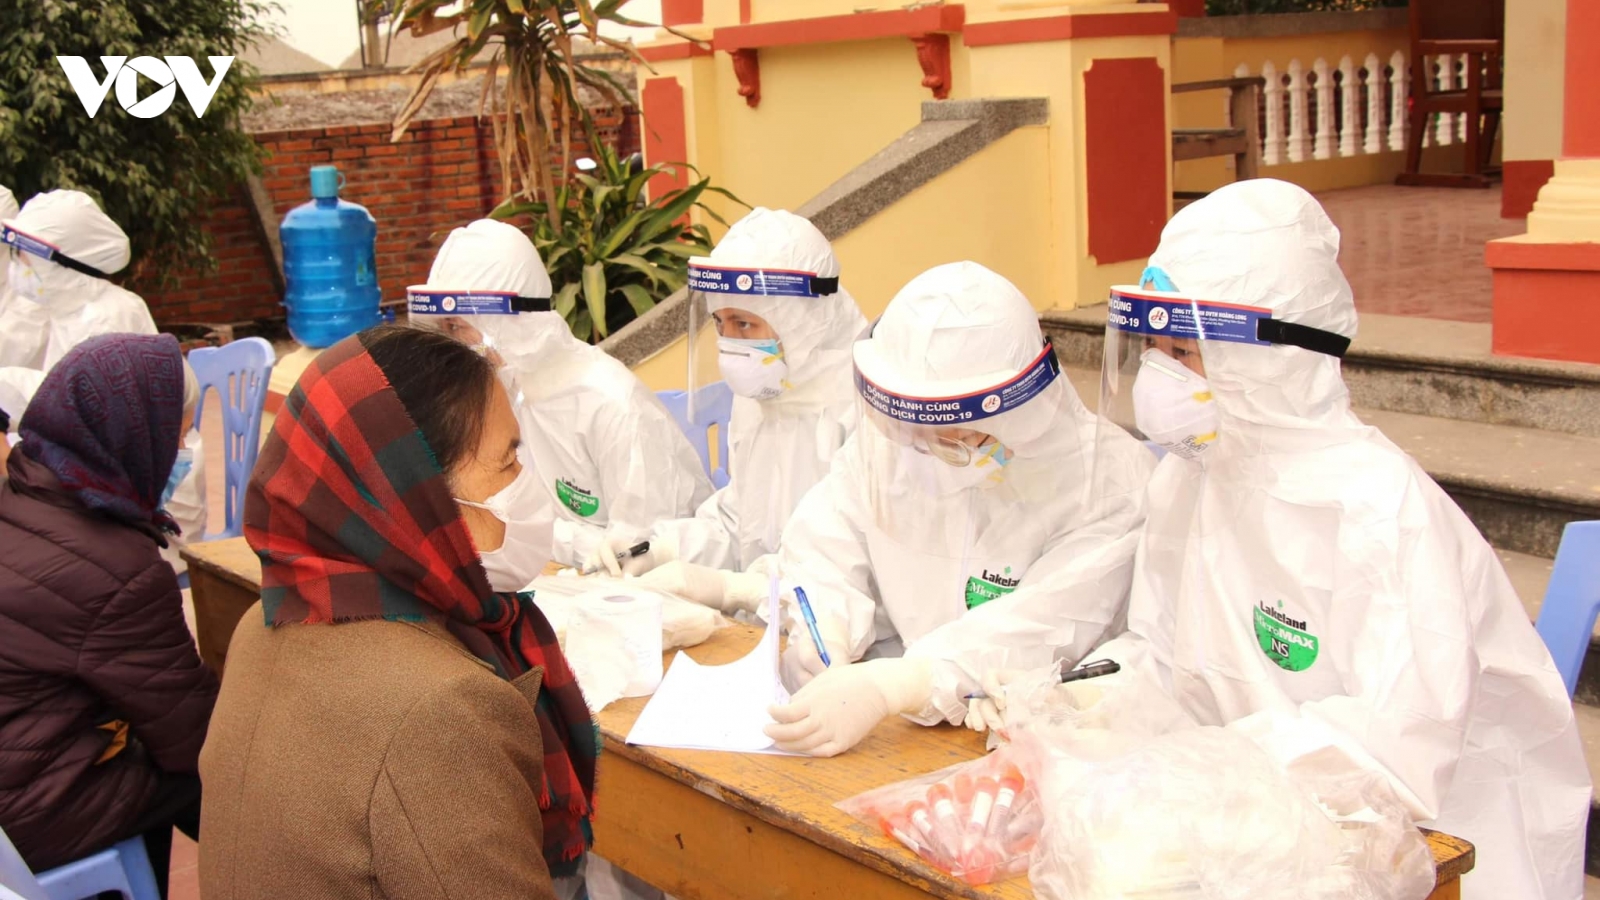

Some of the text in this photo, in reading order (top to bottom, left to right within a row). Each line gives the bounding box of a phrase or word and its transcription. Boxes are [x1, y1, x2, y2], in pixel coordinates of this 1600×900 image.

[702, 270, 722, 280] CÙNG
[698, 281, 730, 291] COVID-19
[412, 304, 437, 312] COVID-19
[1113, 297, 1132, 312] CÙNG
[1109, 312, 1140, 328] COVID-19
[863, 390, 973, 422] CHỐNG DỊCH COVID-19
[867, 385, 960, 412] ĐỒNG HÀNH CÙNG
[982, 569, 1020, 587] Lakela
[1260, 599, 1306, 631] Lakeland
[1255, 611, 1315, 650] MicroMAX
[1271, 638, 1289, 658] NS
